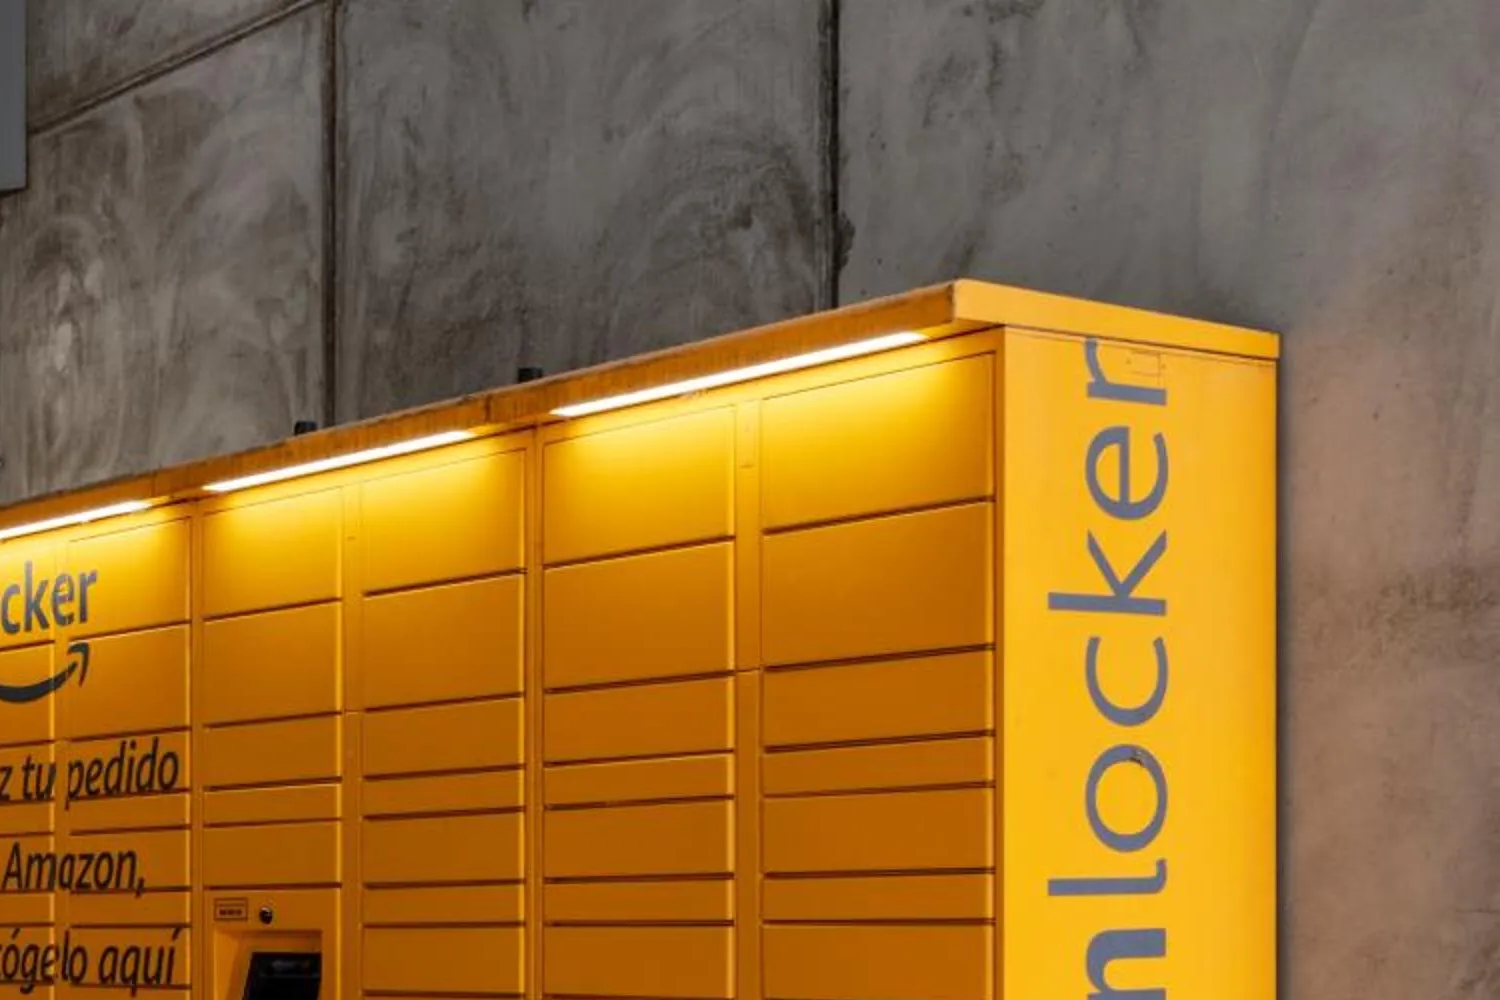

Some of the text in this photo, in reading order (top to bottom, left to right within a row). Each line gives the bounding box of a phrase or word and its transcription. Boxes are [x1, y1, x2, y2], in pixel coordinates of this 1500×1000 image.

[22, 757, 56, 801] tu
[65, 736, 179, 811] pedido
[2, 842, 145, 898] Amazon,
[98, 926, 182, 997] aquí
